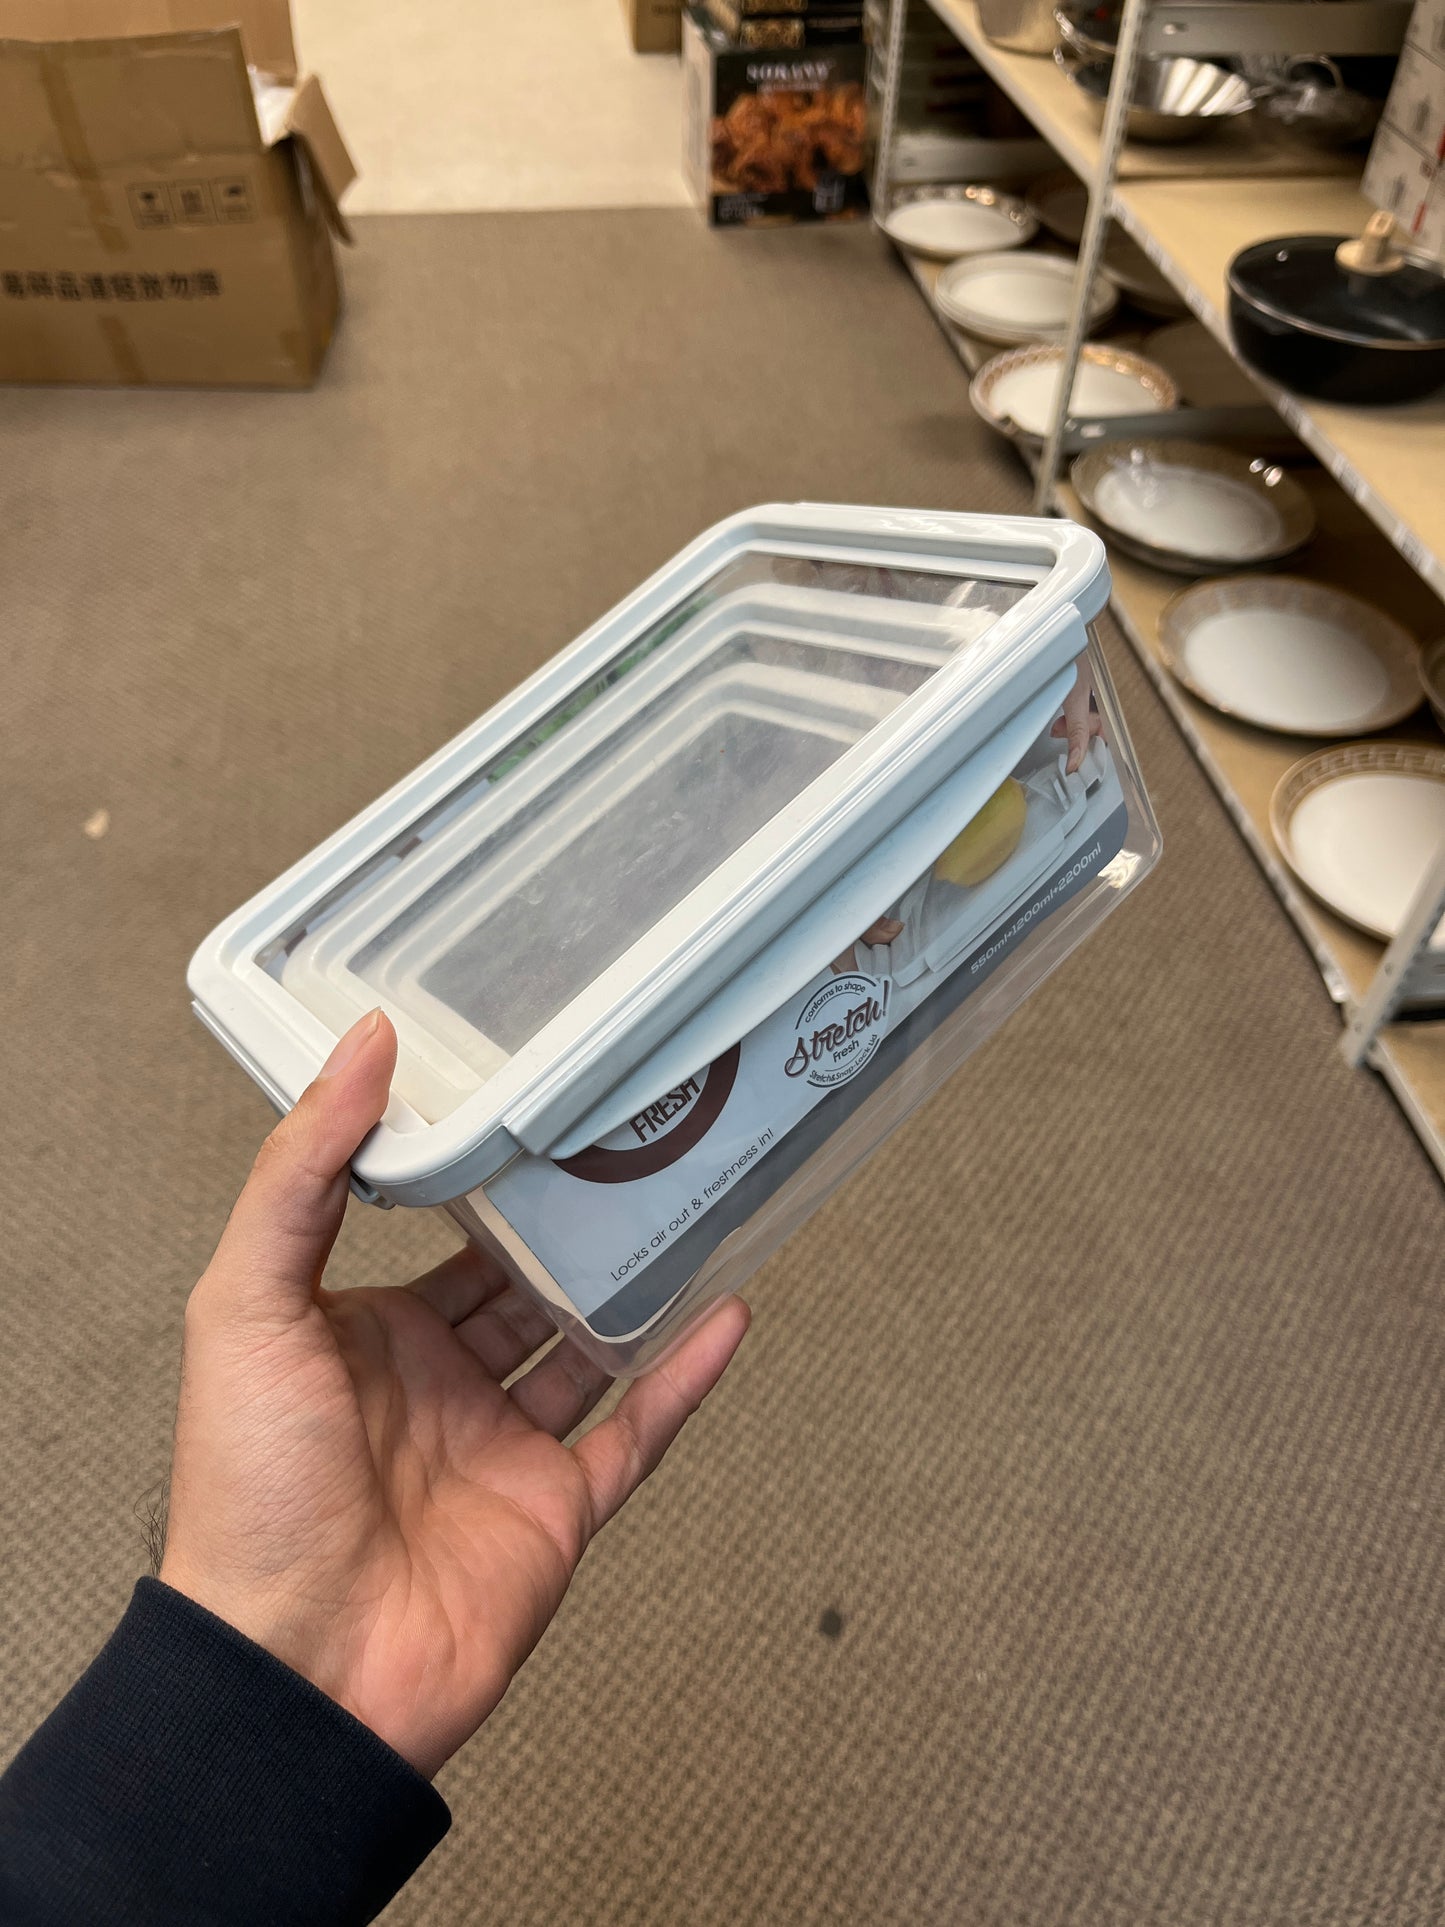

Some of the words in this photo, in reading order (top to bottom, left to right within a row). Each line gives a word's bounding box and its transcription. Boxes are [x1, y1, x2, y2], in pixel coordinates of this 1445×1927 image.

[970, 842, 1102, 975] 550ml+1200ml+2200ml
[784, 979, 890, 1078] Stretch!
[805, 989, 835, 1023] conforms
[844, 981, 867, 993] shape
[832, 1039, 861, 1063] Fresh
[629, 1077, 701, 1143] FRESH
[610, 1246, 650, 1281] Locks
[650, 1229, 667, 1248] air
[668, 1207, 691, 1232] out
[691, 1198, 704, 1210] &
[703, 1144, 759, 1199] freshness
[758, 1127, 775, 1147] in!
